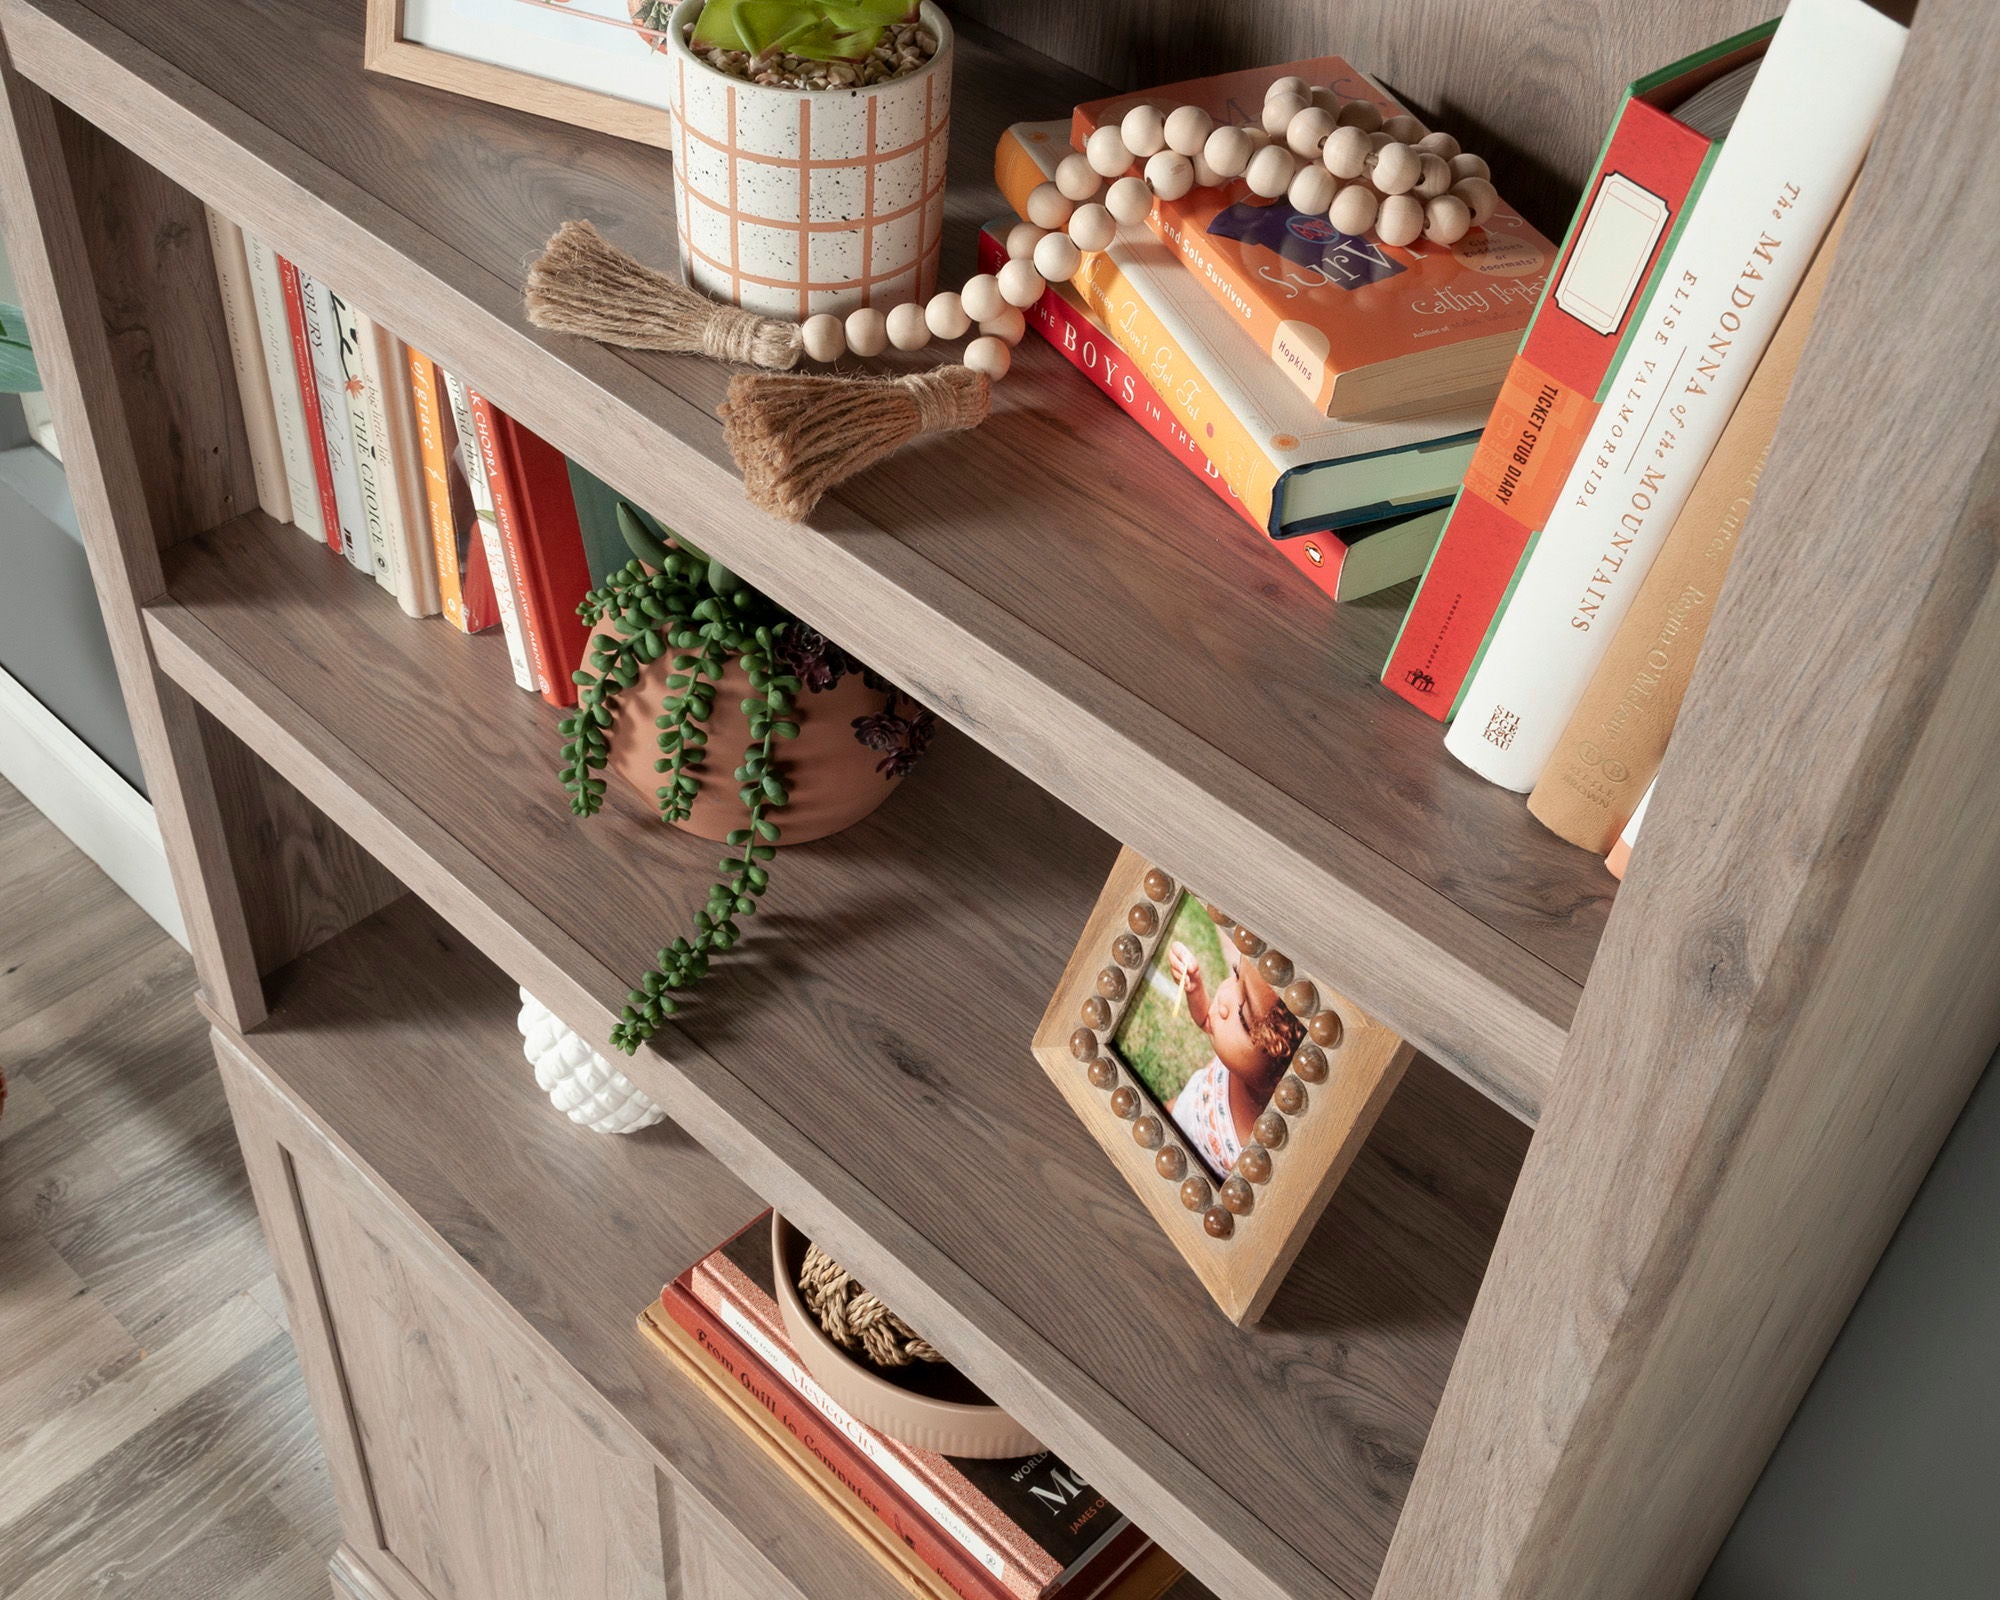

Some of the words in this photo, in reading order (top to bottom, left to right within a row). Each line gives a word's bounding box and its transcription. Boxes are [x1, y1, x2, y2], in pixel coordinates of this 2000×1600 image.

[1771, 181, 1801, 220] The
[1163, 221, 1182, 244] and
[1182, 239, 1204, 269] Sole
[1204, 262, 1253, 319] Survivors
[1411, 286, 1490, 315] Cathy
[1654, 269, 1698, 345] ELISE
[1684, 230, 1782, 396] MADONNA
[410, 361, 430, 389] of
[1062, 320, 1137, 404] BOYS
[1144, 400, 1161, 422] IN
[1170, 422, 1197, 453] THE
[1278, 340, 1313, 381] Hopkins
[353, 409, 371, 459] THE
[413, 386, 434, 450] grace
[450, 376, 473, 438] orchid
[464, 440, 486, 489] thief
[1528, 384, 1559, 432] TICKET
[1575, 359, 1657, 508] VALMORBIDA
[1669, 404, 1687, 429] of
[475, 412, 498, 477] CHOPRA
[1512, 430, 1537, 465] STUB
[1655, 430, 1676, 458] the
[360, 463, 385, 548] CHOICE
[1495, 464, 1523, 506] DIARY
[1570, 464, 1666, 632] MOUNTAINS
[1658, 585, 1707, 646] Regina
[696, 1328, 734, 1374] From
[740, 1371, 777, 1413] Quill
[782, 1414, 798, 1435] to
[803, 1434, 881, 1515] Computer
[790, 1366, 844, 1426] Mexico
[846, 1421, 877, 1457] City
[1070, 1506, 1097, 1535] JAMES
